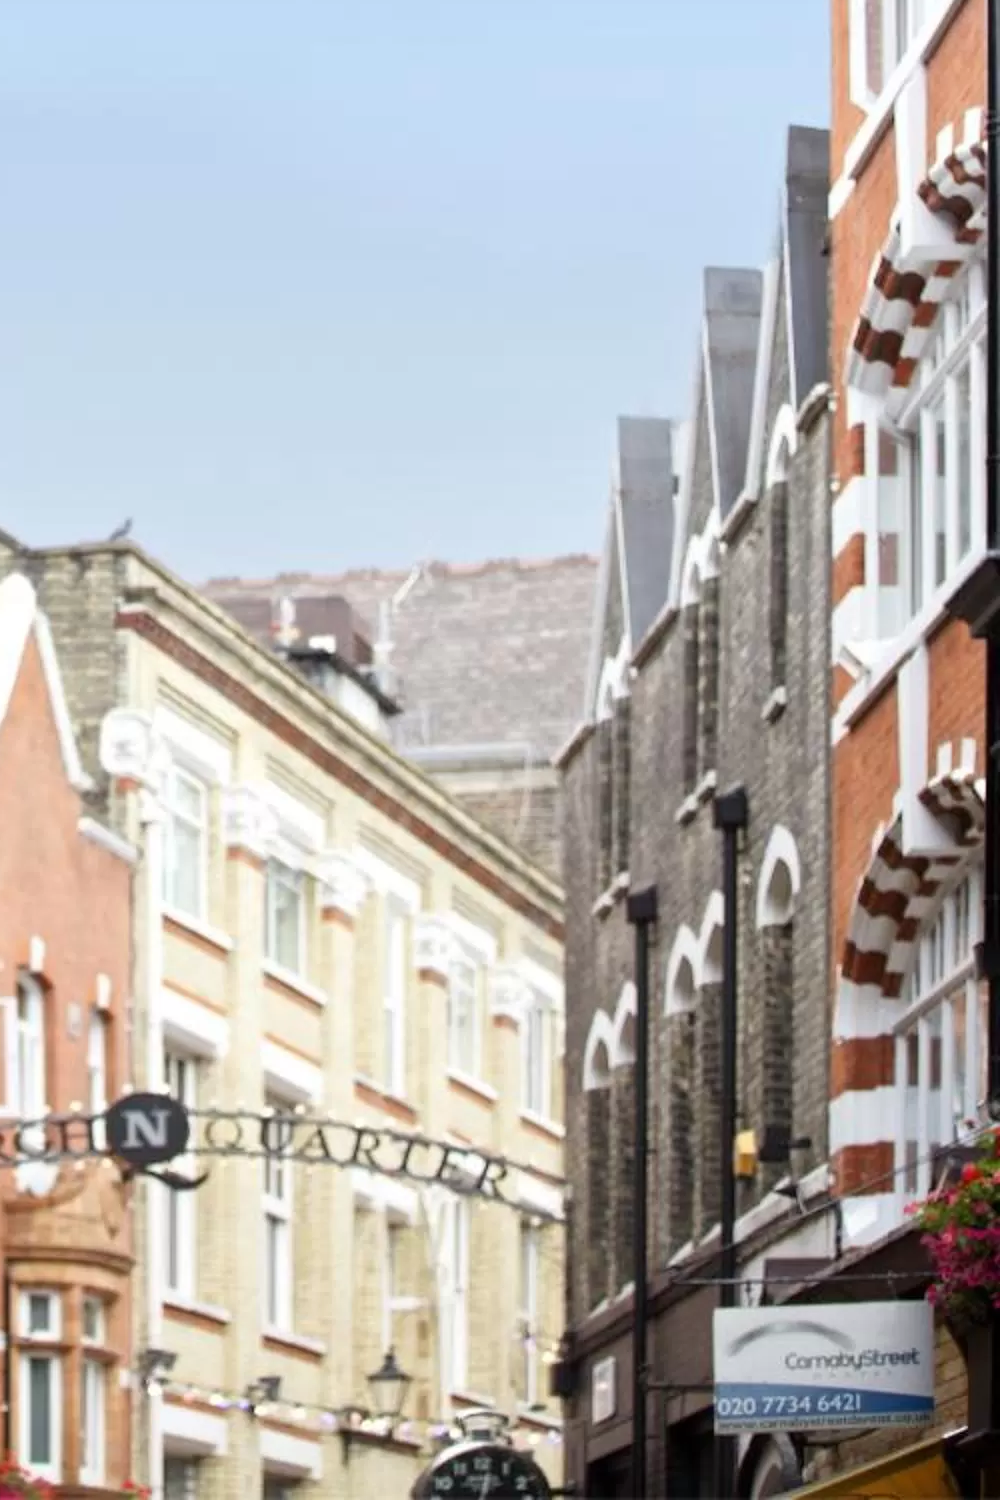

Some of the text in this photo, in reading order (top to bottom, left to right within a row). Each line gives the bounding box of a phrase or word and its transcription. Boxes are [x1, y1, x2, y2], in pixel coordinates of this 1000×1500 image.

[122, 1109, 172, 1148] N
[205, 1115, 508, 1201] QUARTER
[717, 1392, 861, 1417] 020 7734 6421
